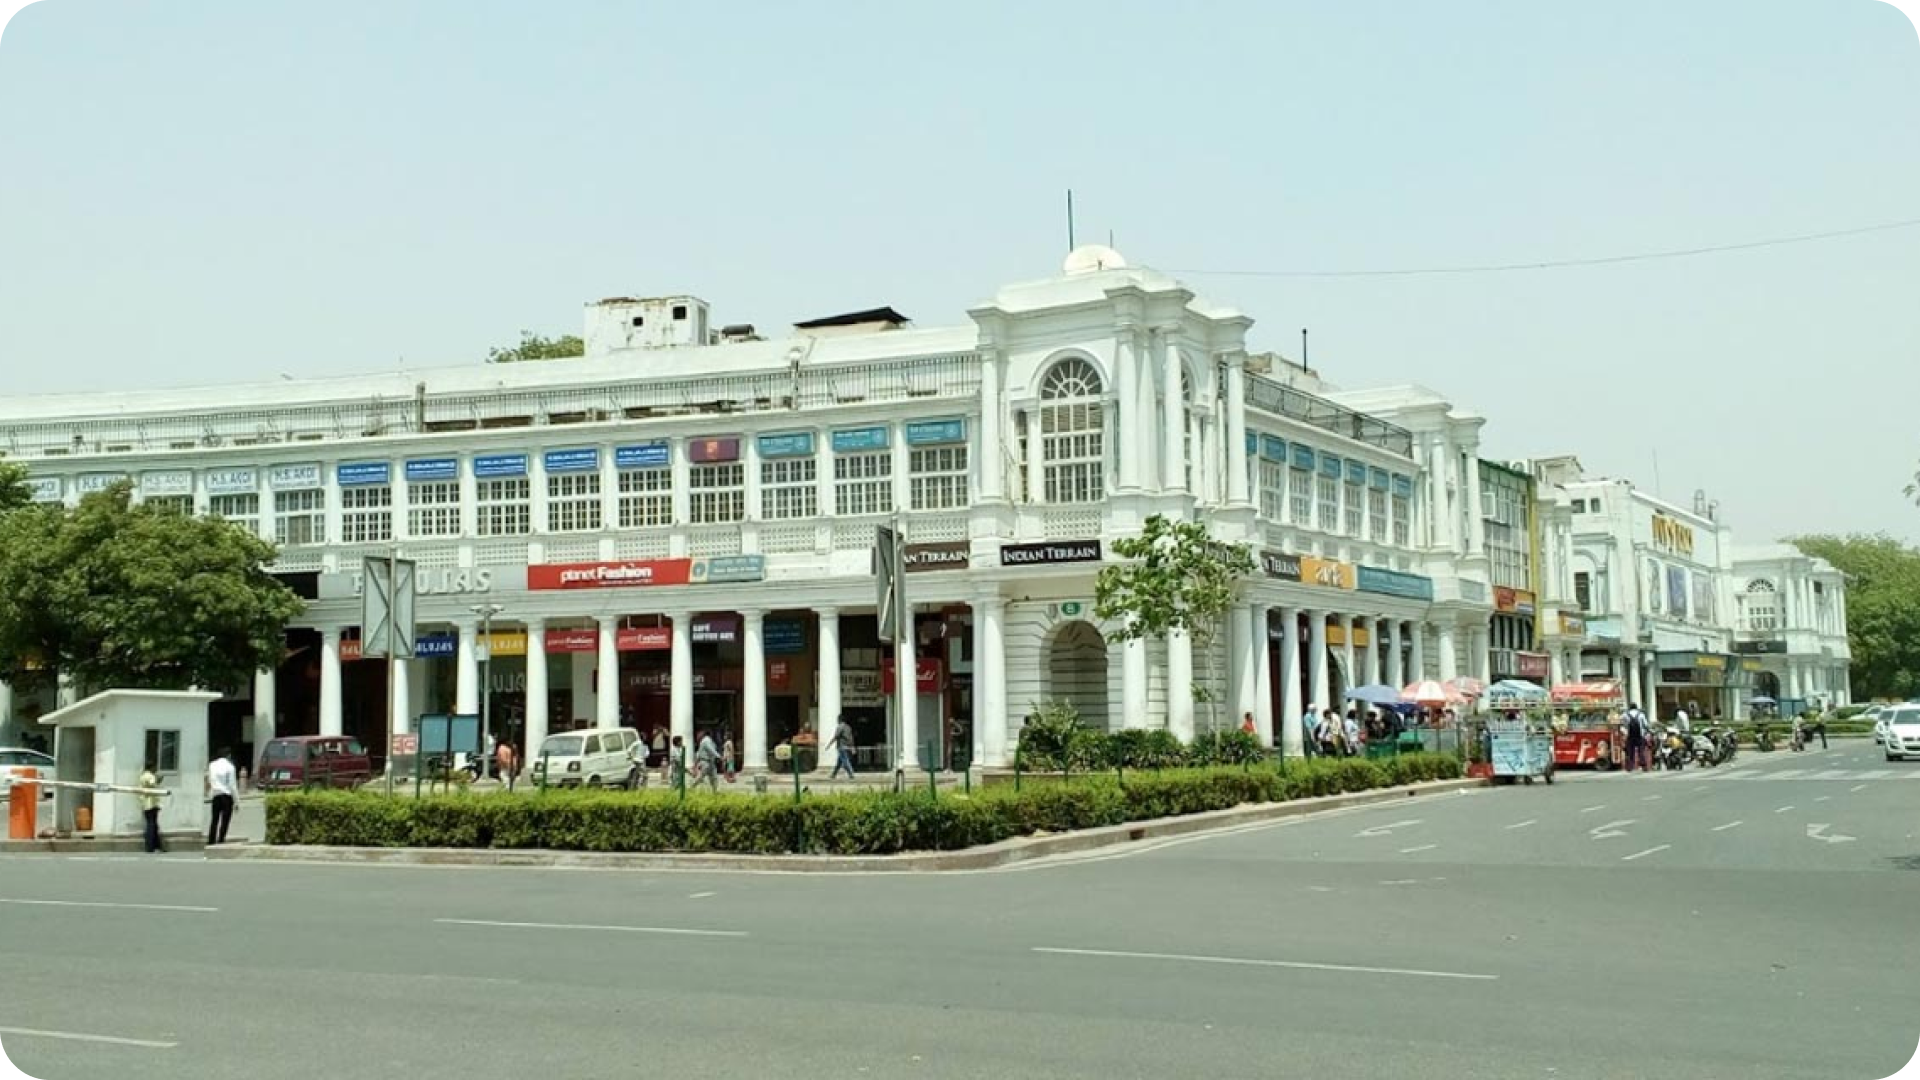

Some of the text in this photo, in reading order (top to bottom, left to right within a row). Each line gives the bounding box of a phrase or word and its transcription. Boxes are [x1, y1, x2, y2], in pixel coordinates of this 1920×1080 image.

[919, 549, 967, 563] TERRAIN
[1003, 546, 1096, 562] INDIAN TERRAIN
[597, 563, 652, 580] Fashion
